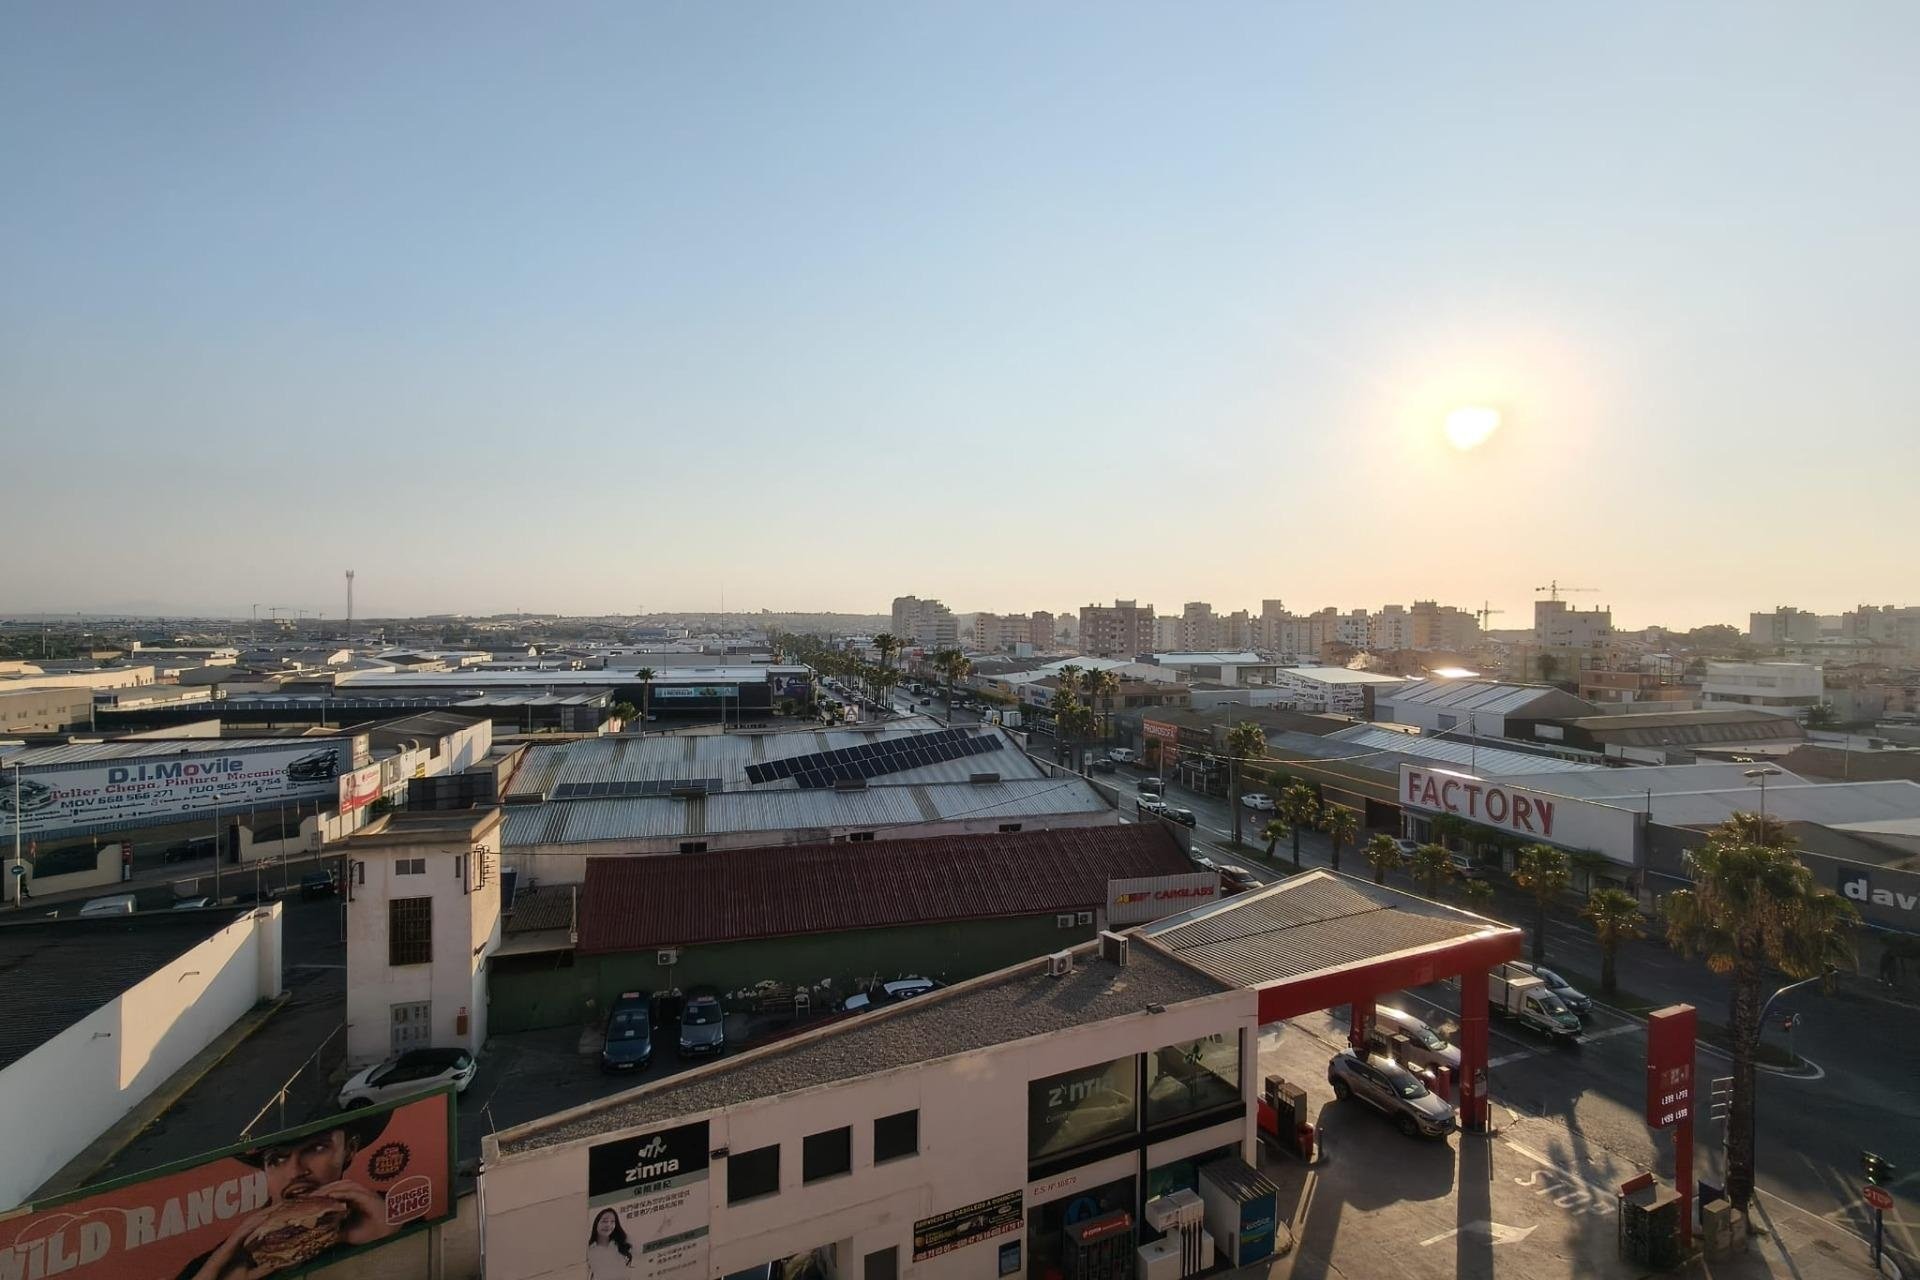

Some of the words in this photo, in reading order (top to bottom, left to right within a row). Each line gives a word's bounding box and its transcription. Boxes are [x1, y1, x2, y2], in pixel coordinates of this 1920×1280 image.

[108, 758, 243, 785] D.I.Movile
[51, 787, 100, 800] Taller
[165, 775, 218, 787] Pintura
[61, 798, 95, 809] MOV
[153, 789, 173, 799] 271
[1408, 771, 1555, 838] FACTORY
[625, 1158, 679, 1182] zintia
[388, 1185, 429, 1206] BURGER
[388, 1196, 429, 1219] KING
[1863, 1188, 1892, 1207] STOP
[125, 1169, 268, 1250] RANCH
